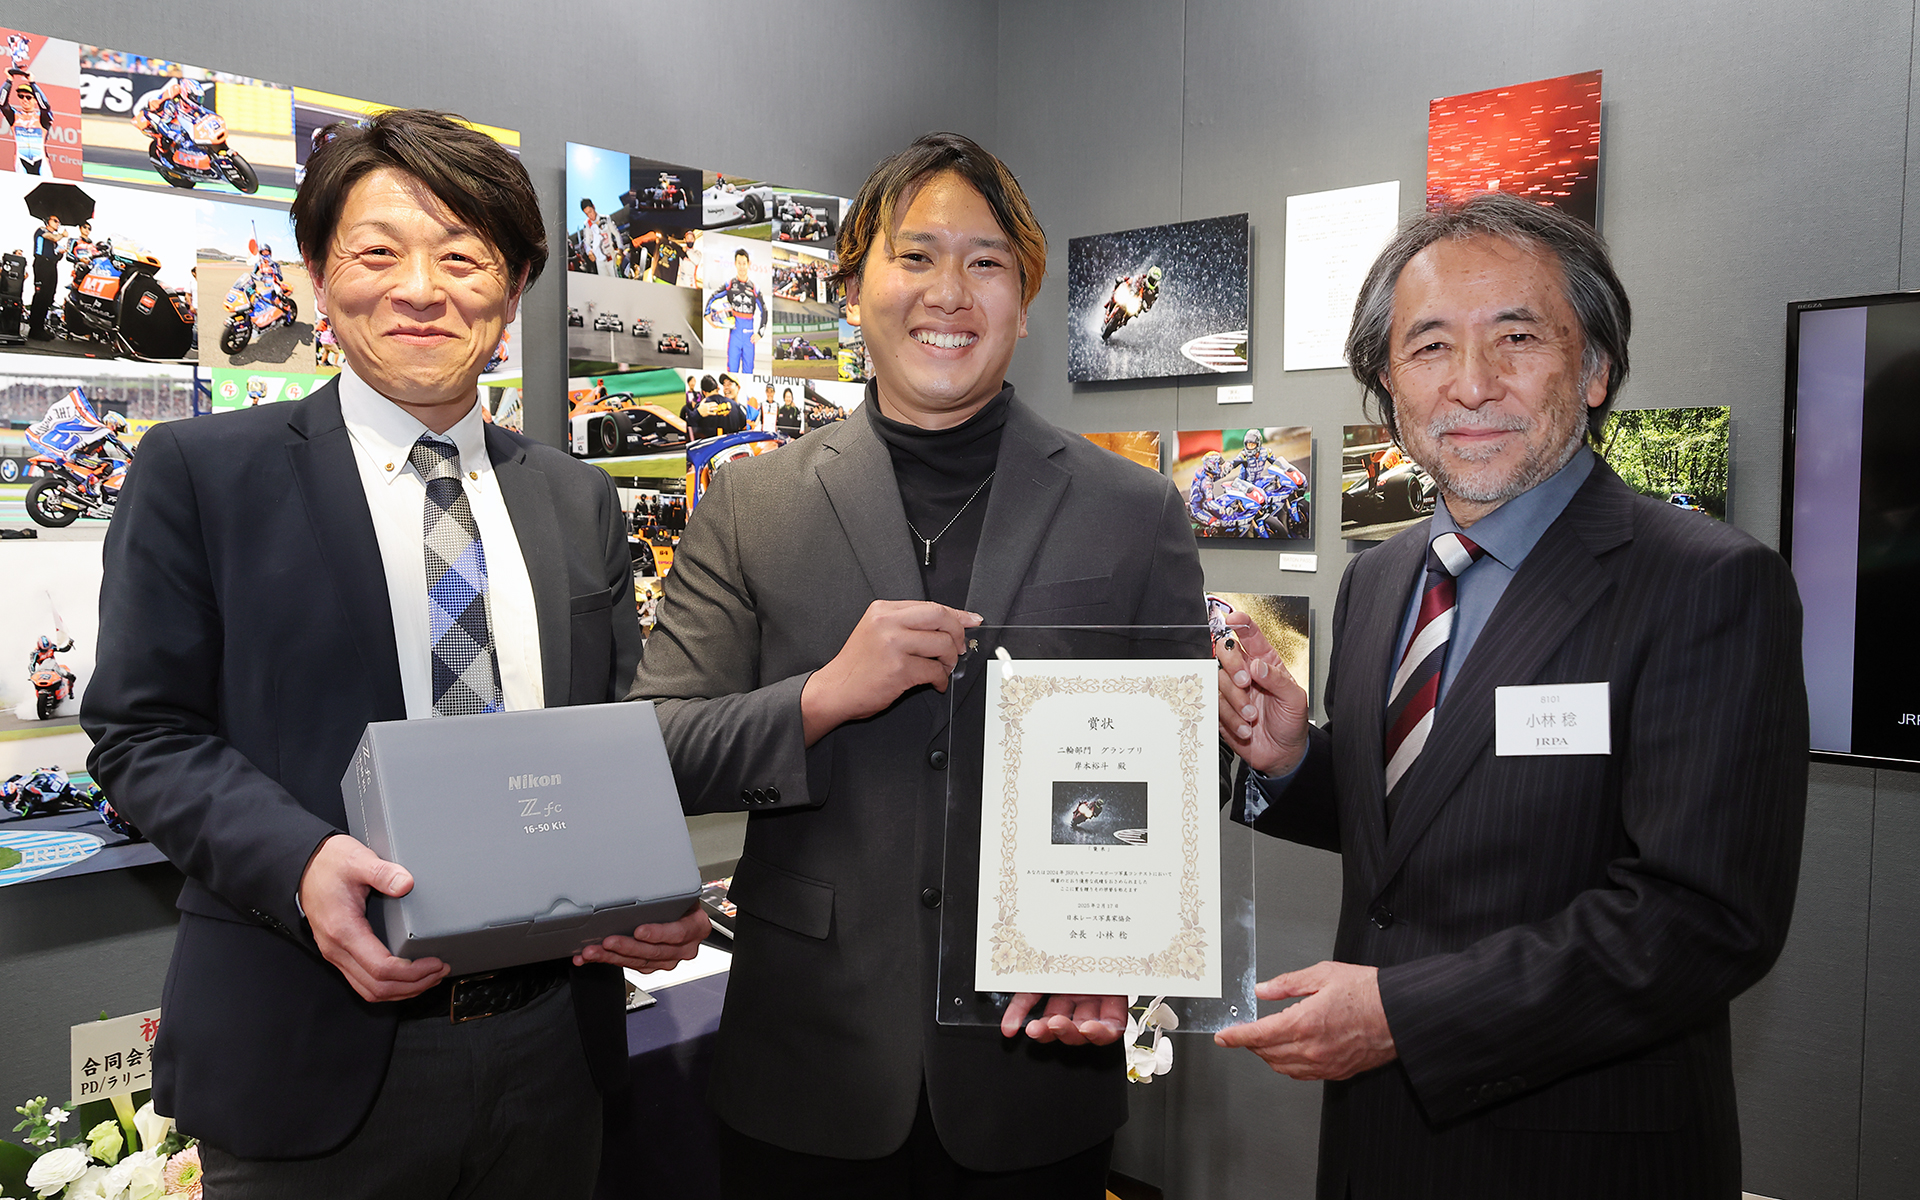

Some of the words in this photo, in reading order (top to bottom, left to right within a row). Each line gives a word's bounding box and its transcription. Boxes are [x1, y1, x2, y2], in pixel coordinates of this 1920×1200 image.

[1540, 695, 1561, 704] 8101
[1087, 716, 1115, 731] 賞状
[1526, 713, 1556, 728] 小林
[1561, 711, 1577, 728] 稔
[1535, 737, 1569, 747] JRPA
[1057, 746, 1092, 755] 二輪部門
[508, 773, 562, 791] Nikon
[518, 798, 541, 817] Z
[523, 822, 550, 834] 16-50
[551, 820, 567, 830] Kit
[20, 843, 88, 867] JRPA
[1069, 929, 1087, 940] 会長
[1096, 930, 1114, 940] 小林
[80, 1070, 153, 1096] PD/ラリー
